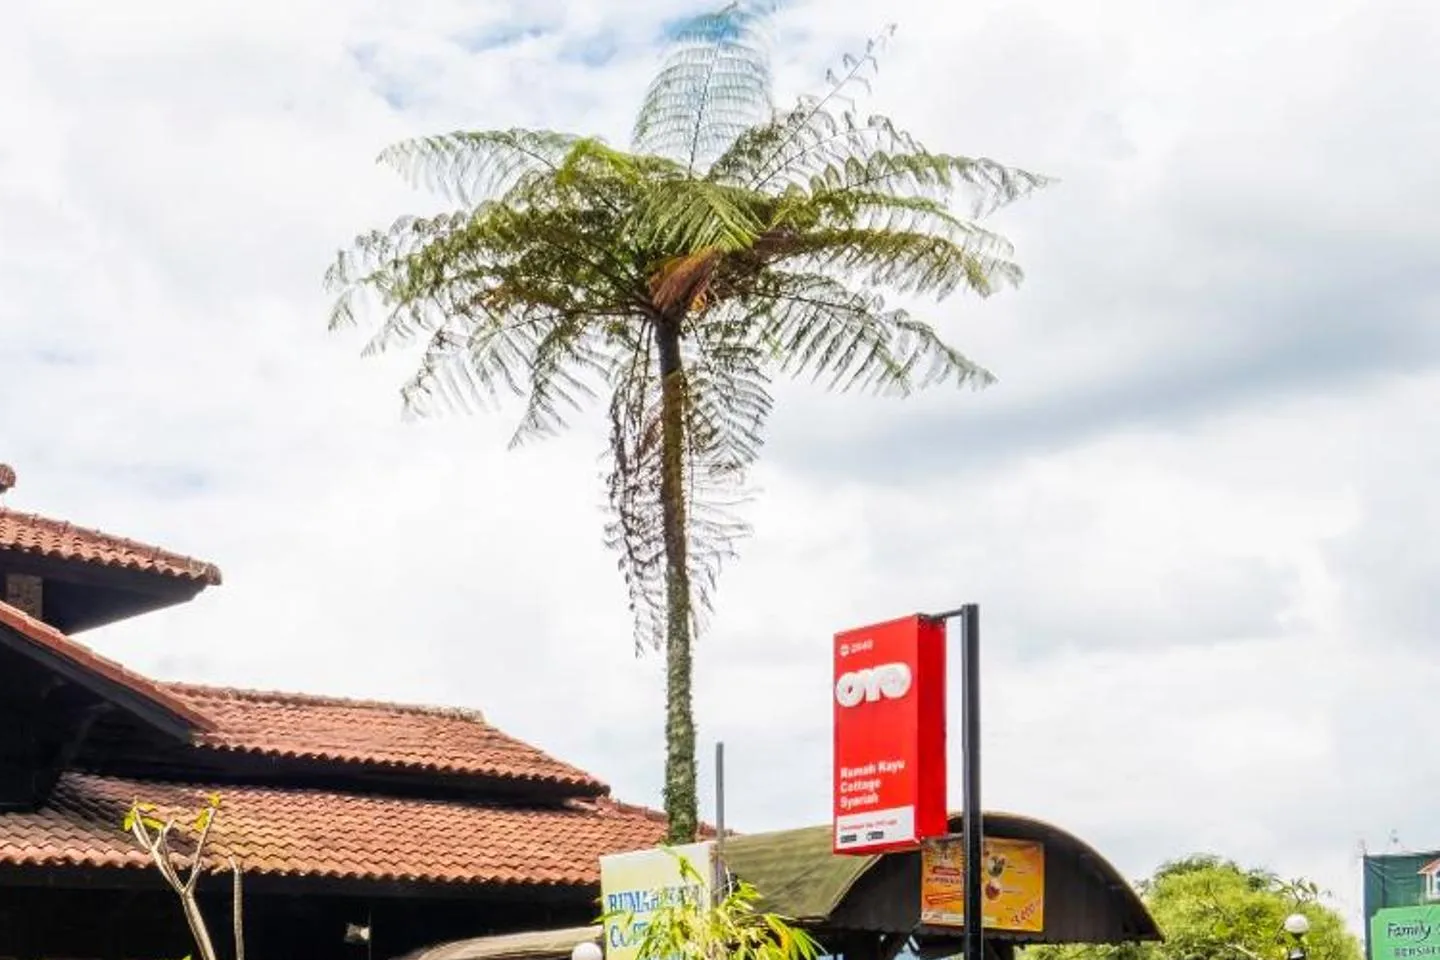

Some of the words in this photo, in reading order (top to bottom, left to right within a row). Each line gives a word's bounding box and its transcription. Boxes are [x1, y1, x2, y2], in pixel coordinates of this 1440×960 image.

[836, 662, 912, 706] OYO
[841, 764, 876, 778] Rumah
[878, 760, 905, 774] Kayu
[841, 779, 881, 793] Cottage
[1388, 920, 1431, 943] Family
